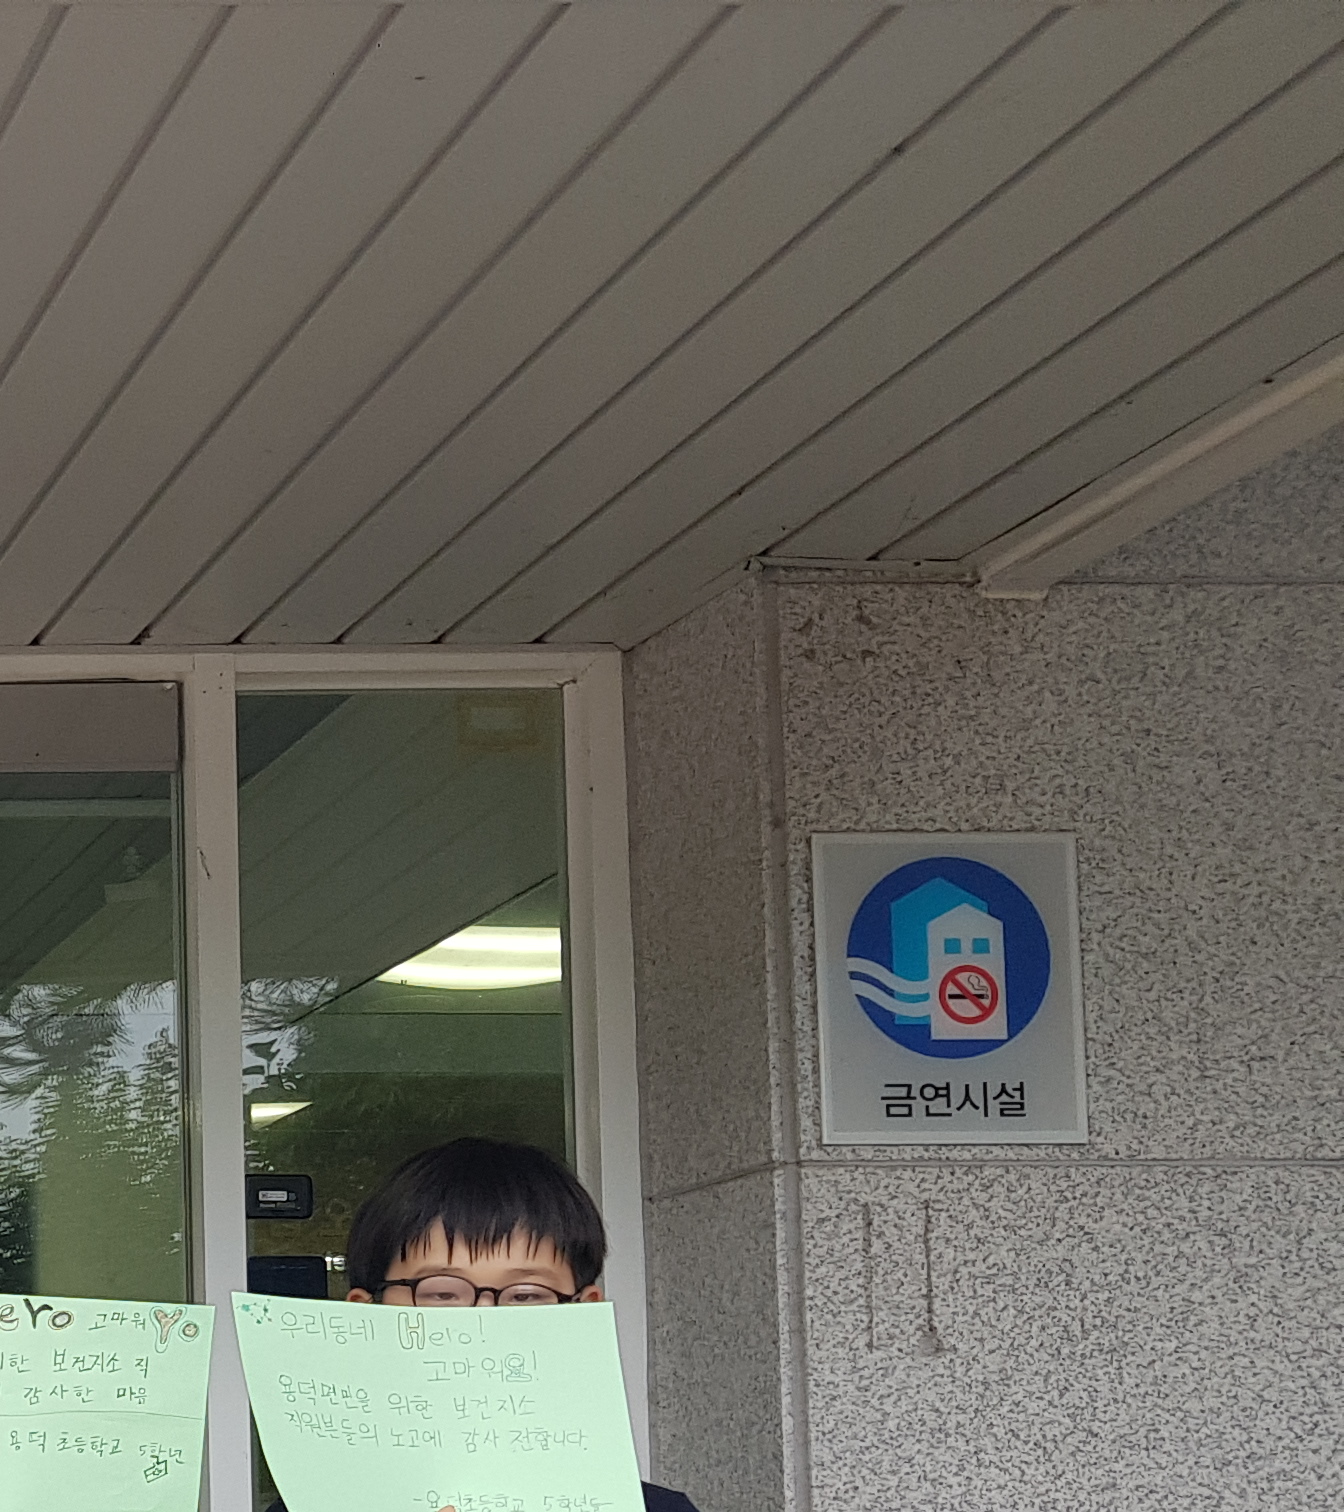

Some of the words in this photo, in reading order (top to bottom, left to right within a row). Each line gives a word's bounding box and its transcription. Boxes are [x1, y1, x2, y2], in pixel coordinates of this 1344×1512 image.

[880, 1081, 1027, 1118] 금연시설
[280, 1310, 376, 1345] 우리동네
[52, 1348, 123, 1374] 보건지소
[134, 1355, 150, 1379] 직
[23, 1383, 95, 1405] 감사한
[387, 1392, 434, 1420] 위한
[453, 1394, 536, 1420] 보건지소
[390, 1428, 443, 1449] 노고에
[461, 1429, 499, 1454] 감사
